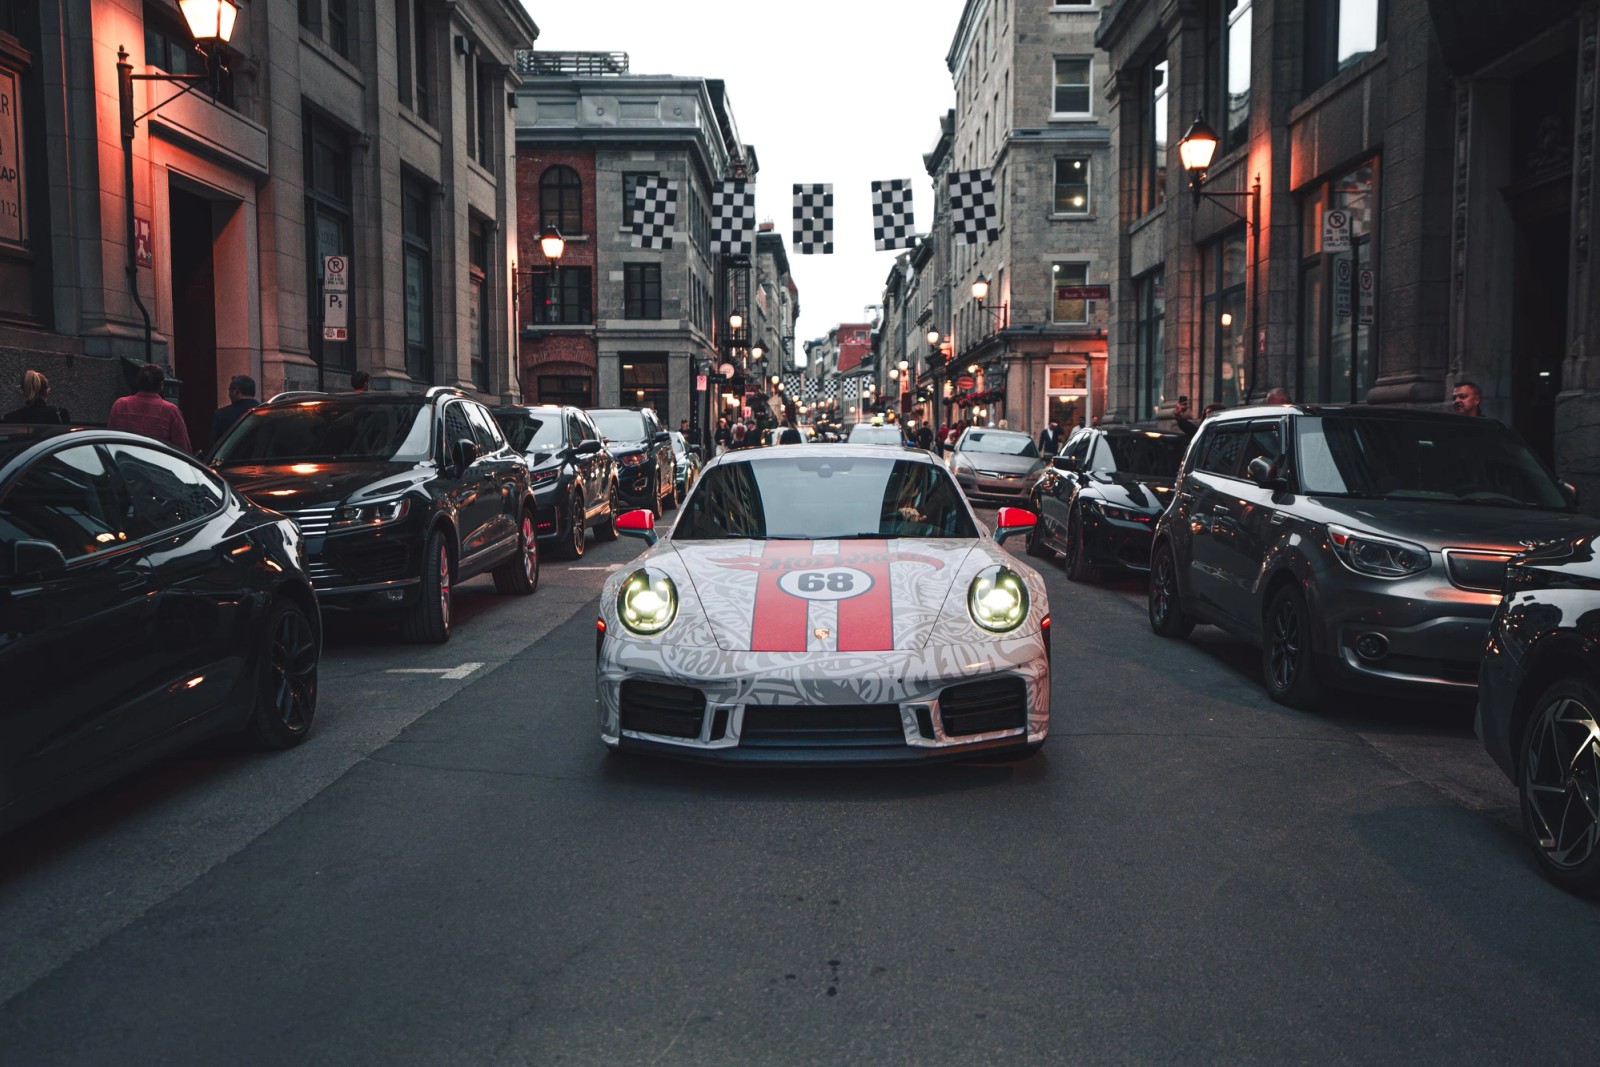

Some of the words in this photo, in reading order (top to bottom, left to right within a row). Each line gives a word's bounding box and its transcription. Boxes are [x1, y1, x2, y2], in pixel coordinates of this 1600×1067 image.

[0, 93, 10, 117] R
[0, 166, 17, 184] AP
[797, 572, 854, 592] 68
